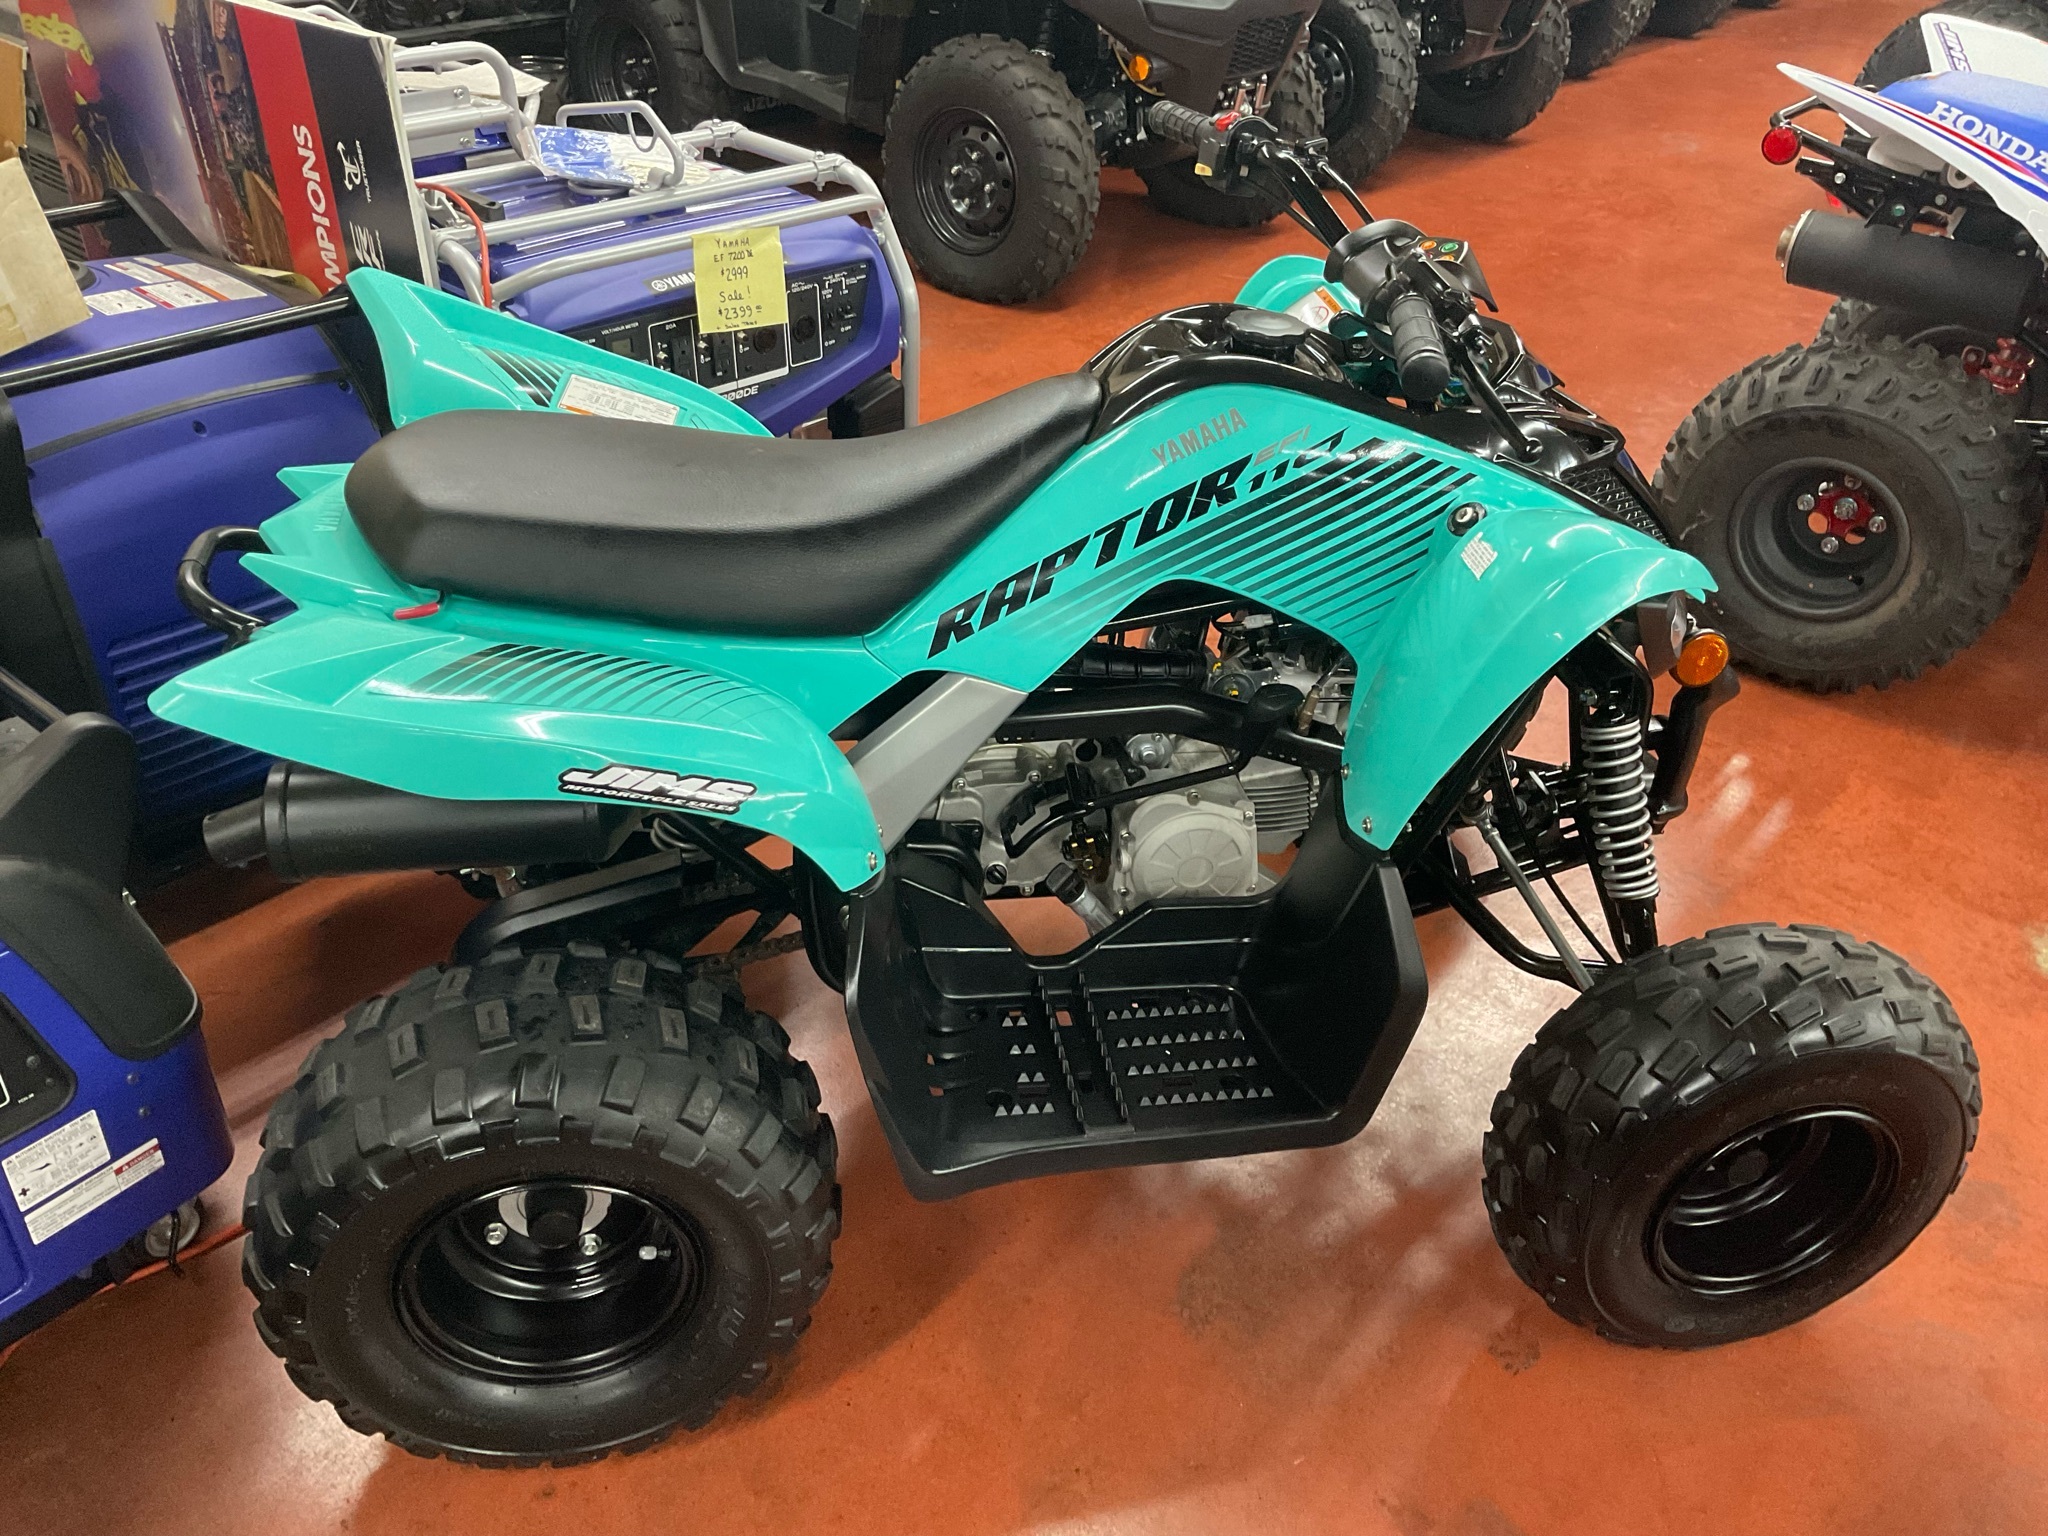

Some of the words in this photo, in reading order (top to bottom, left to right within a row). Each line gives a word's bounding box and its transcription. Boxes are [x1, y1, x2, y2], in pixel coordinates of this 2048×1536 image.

[1938, 22, 1972, 73] JIMS
[1928, 101, 2048, 174] HONDA
[355, 140, 372, 203] TRUETIMBER
[292, 124, 343, 291] MPIONS
[714, 237, 750, 249] YAMAHA
[714, 253, 724, 262] EF
[720, 265, 749, 281] $2999
[718, 304, 753, 320] $2399
[1151, 408, 1248, 468] YAMAHA
[1253, 424, 1312, 467] EFI
[927, 453, 1255, 660] RAPTOR
[562, 766, 757, 805] JIMS
[562, 784, 687, 807] MOTORCYCLE
[686, 800, 738, 812] SALES
